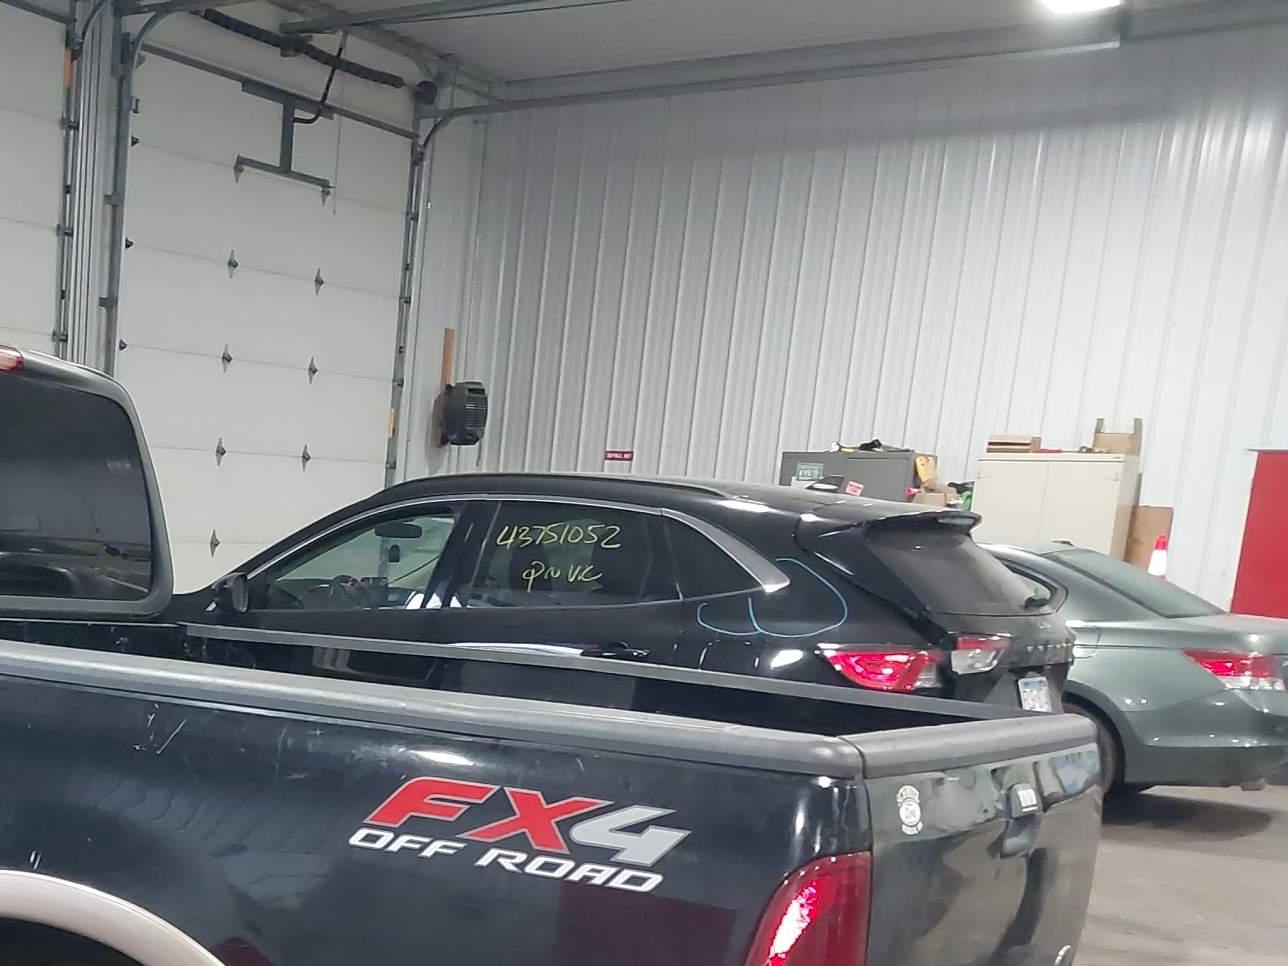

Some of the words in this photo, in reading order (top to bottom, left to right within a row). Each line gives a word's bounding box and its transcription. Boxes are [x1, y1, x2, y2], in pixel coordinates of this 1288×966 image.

[496, 522, 622, 549] 43751052
[363, 776, 692, 867] FX4
[348, 827, 468, 859] OFF
[473, 847, 665, 893] ROAD
